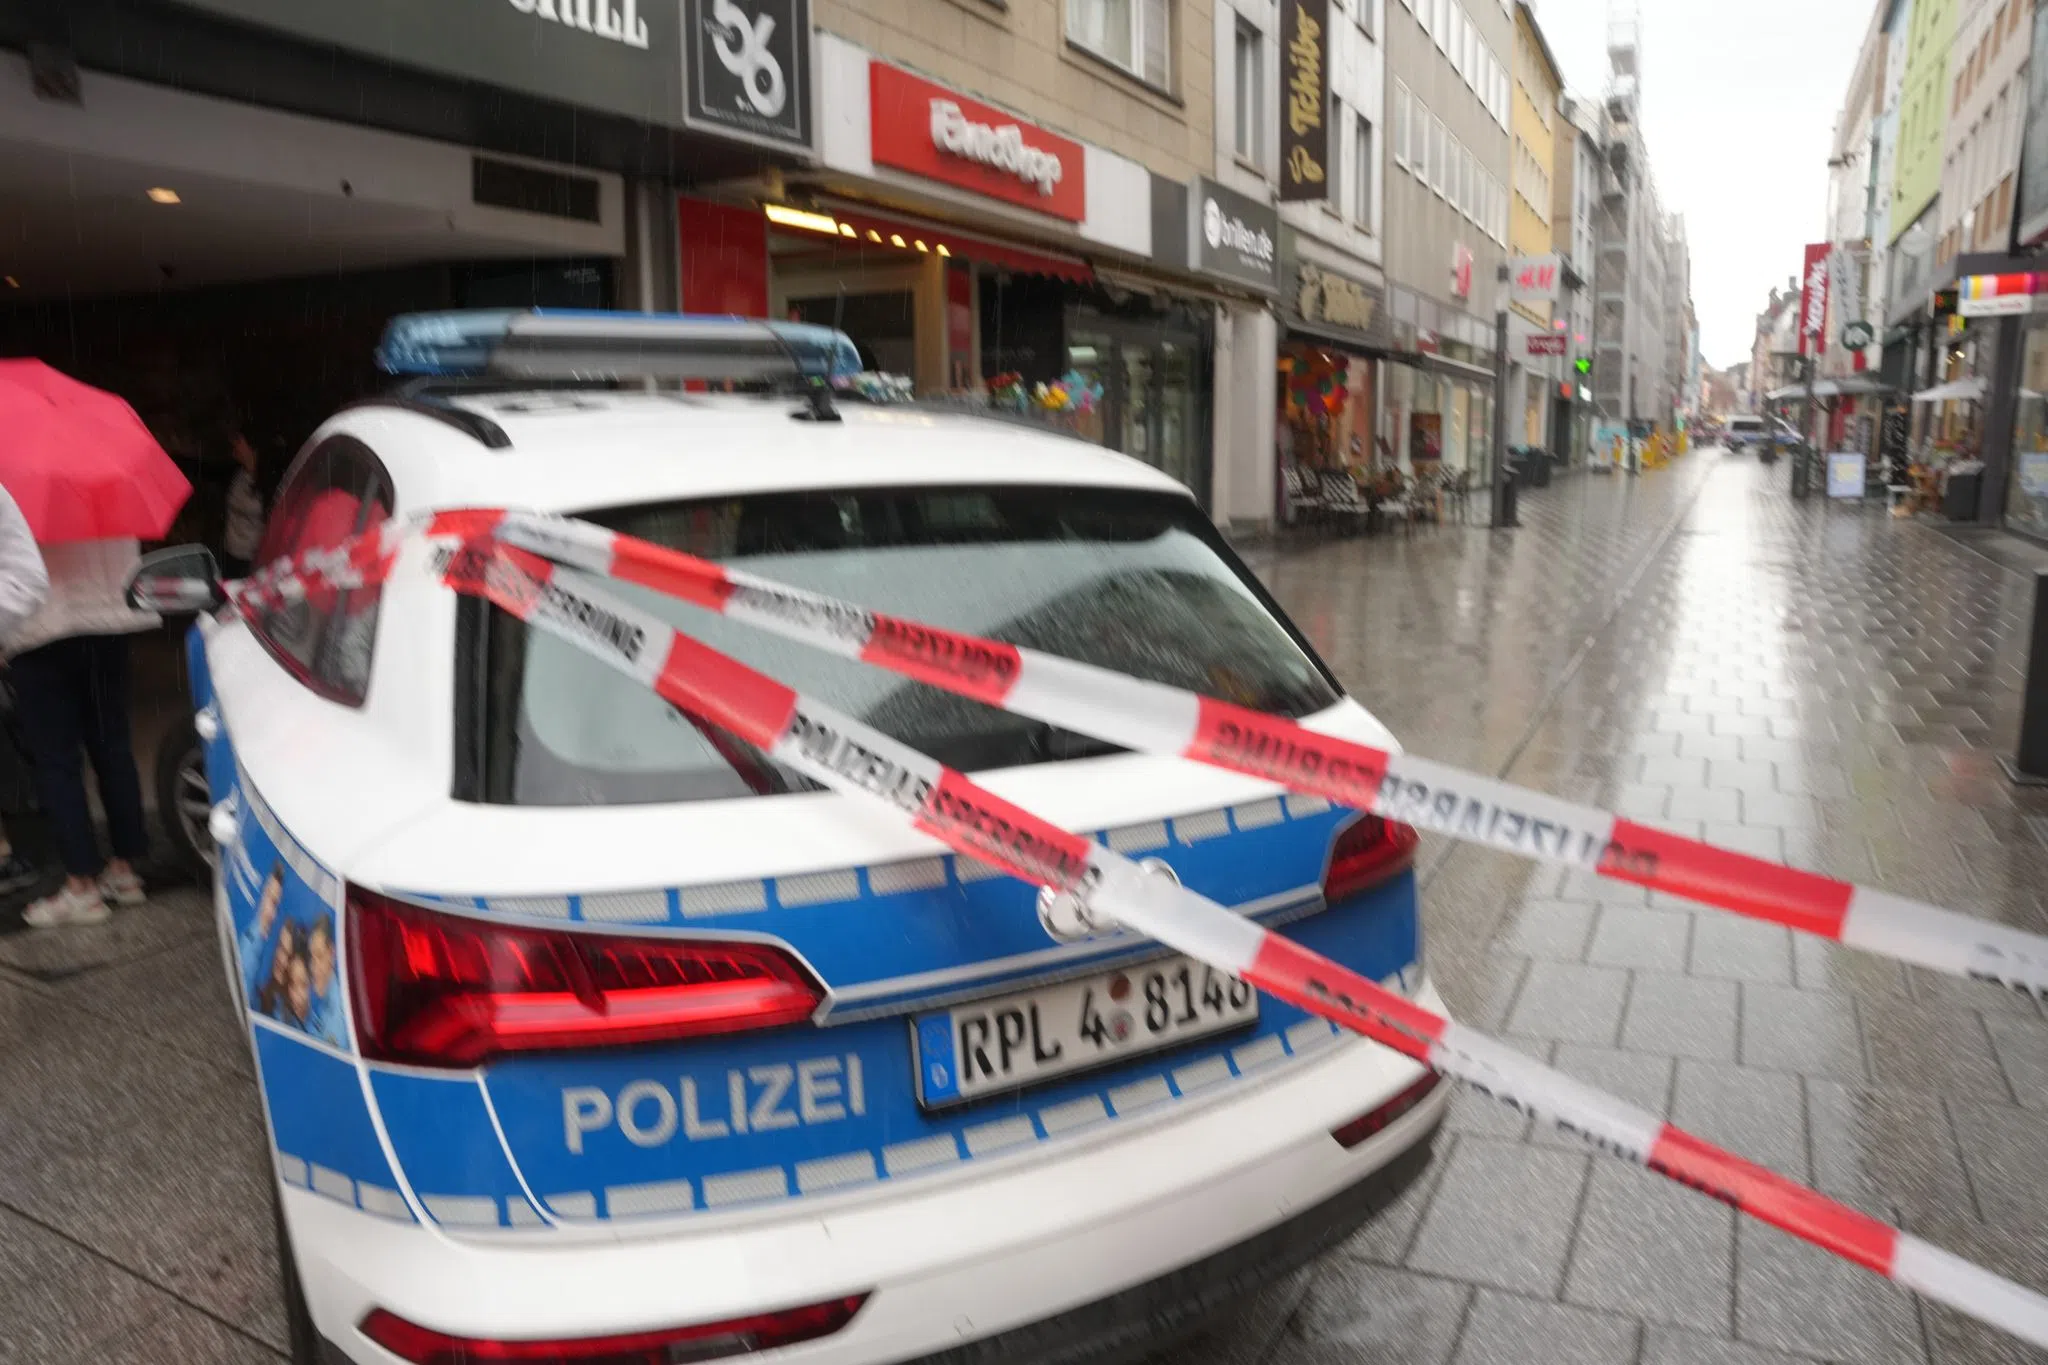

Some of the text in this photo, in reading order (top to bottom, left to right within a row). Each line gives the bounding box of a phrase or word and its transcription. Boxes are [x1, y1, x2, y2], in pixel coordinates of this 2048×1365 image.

[1288, 3, 1322, 137] Tchibo
[961, 1003, 1062, 1081] RPL
[1080, 988, 1110, 1048] 4
[562, 1053, 866, 1156] POLIZEI
